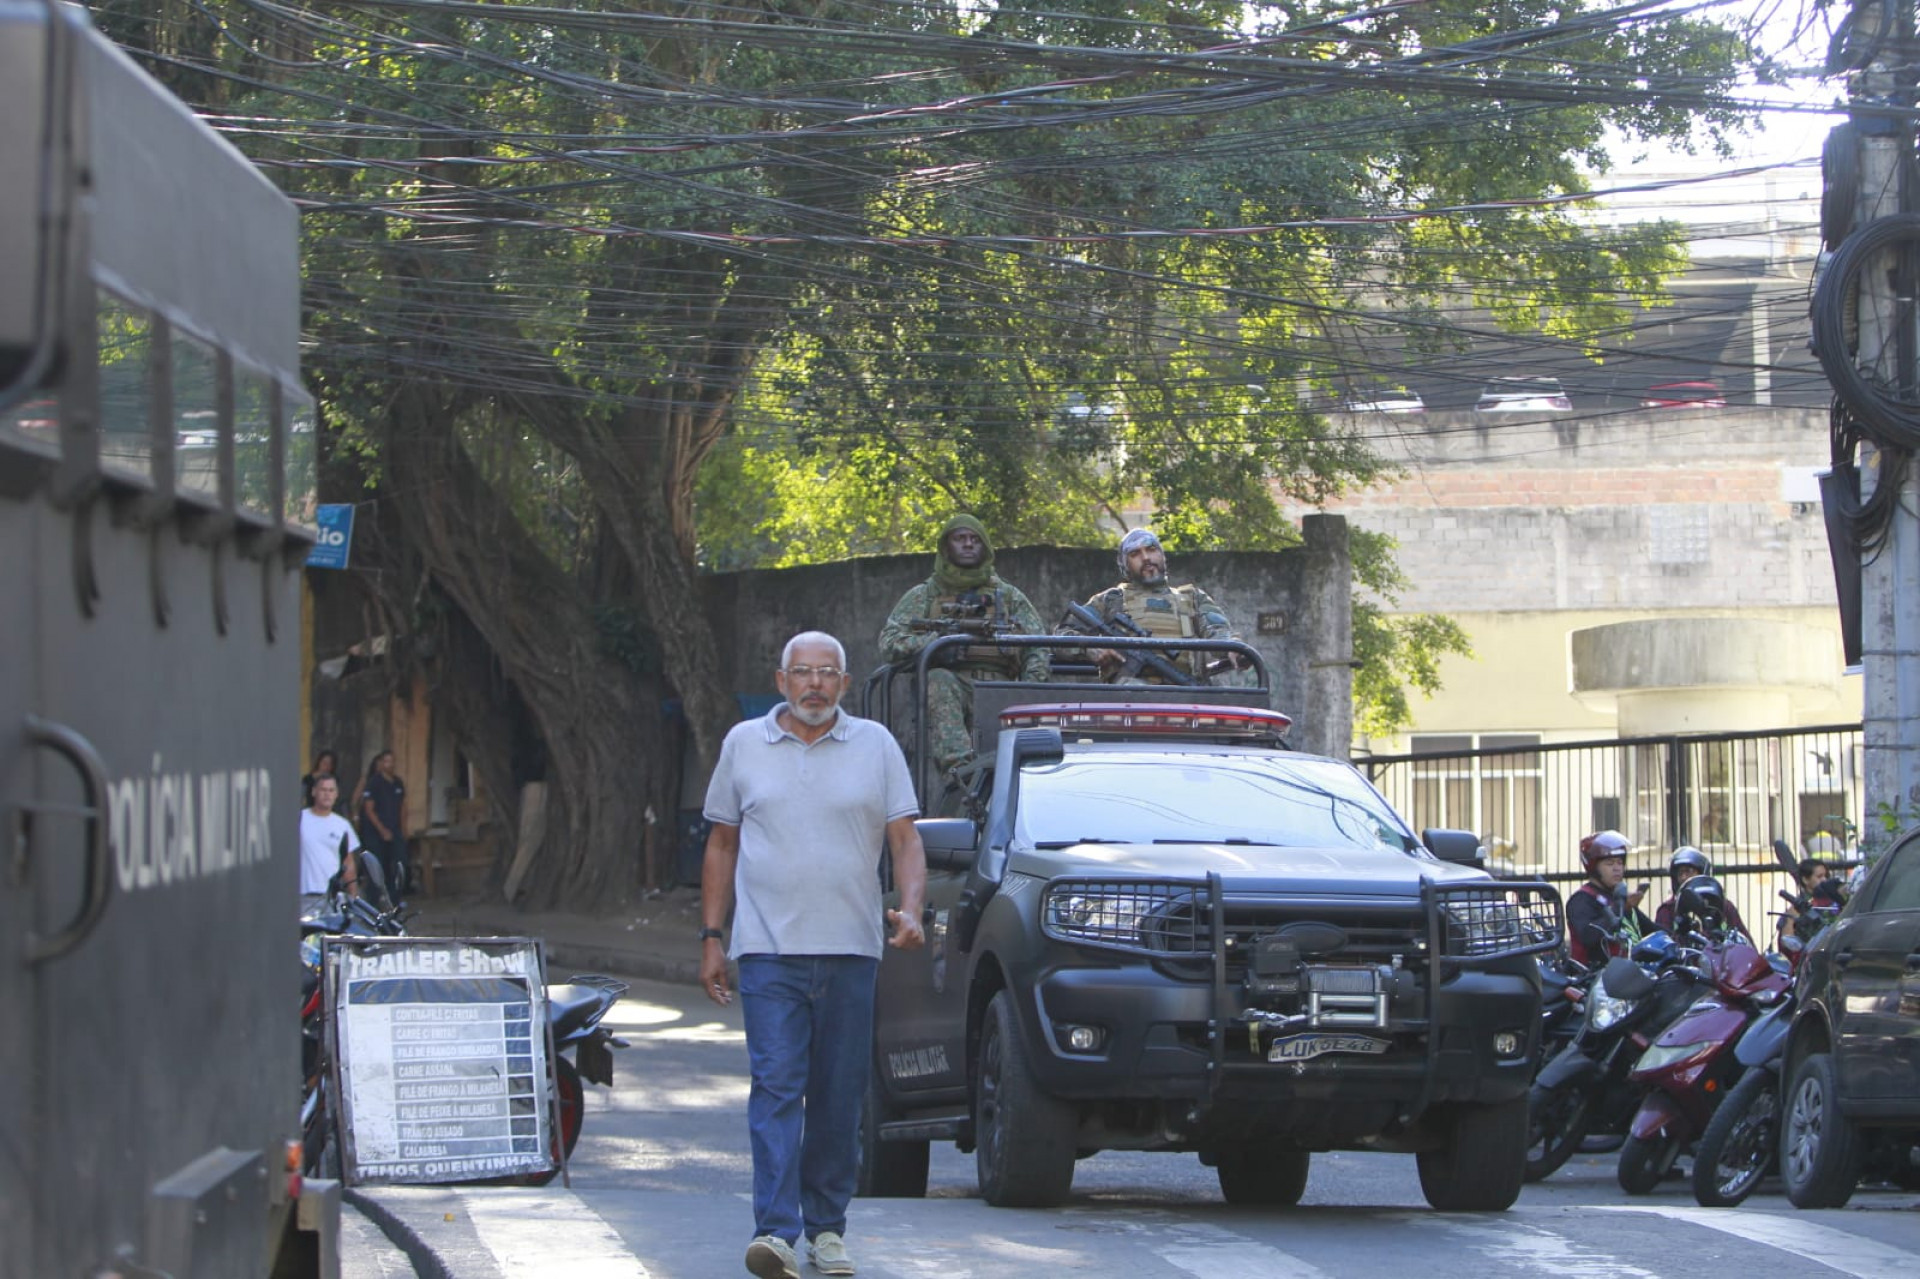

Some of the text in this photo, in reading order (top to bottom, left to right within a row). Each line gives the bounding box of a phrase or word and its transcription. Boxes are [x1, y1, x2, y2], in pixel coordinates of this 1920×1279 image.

[199, 766, 271, 873] MILITAR
[349, 948, 451, 978] TRAILER
[429, 1084, 458, 1097] FRANGO
[356, 1155, 545, 1178] TEMOS QUENTINHAS
